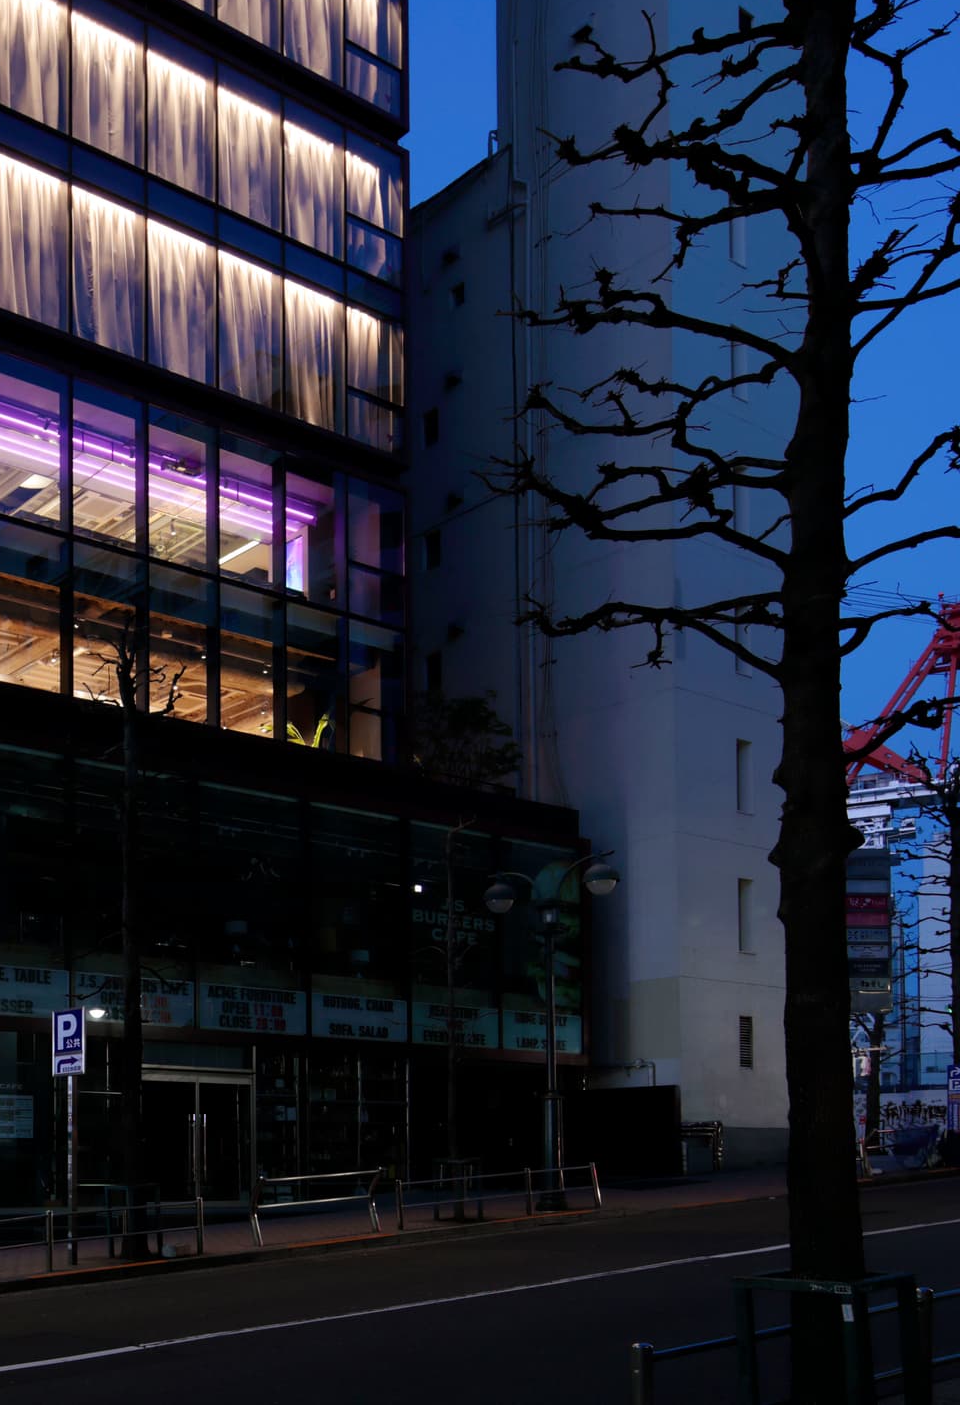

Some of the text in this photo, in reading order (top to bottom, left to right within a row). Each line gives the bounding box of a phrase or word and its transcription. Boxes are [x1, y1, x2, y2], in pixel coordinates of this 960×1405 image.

[411, 907, 496, 932] BURERS
[100, 991, 128, 1006] OPE
[222, 1001, 249, 1014] OPEN
[219, 1014, 253, 1028] CLOSE
[57, 1014, 77, 1050] P
[359, 1026, 389, 1038] SALAD
[66, 1038, 81, 1048] 公共
